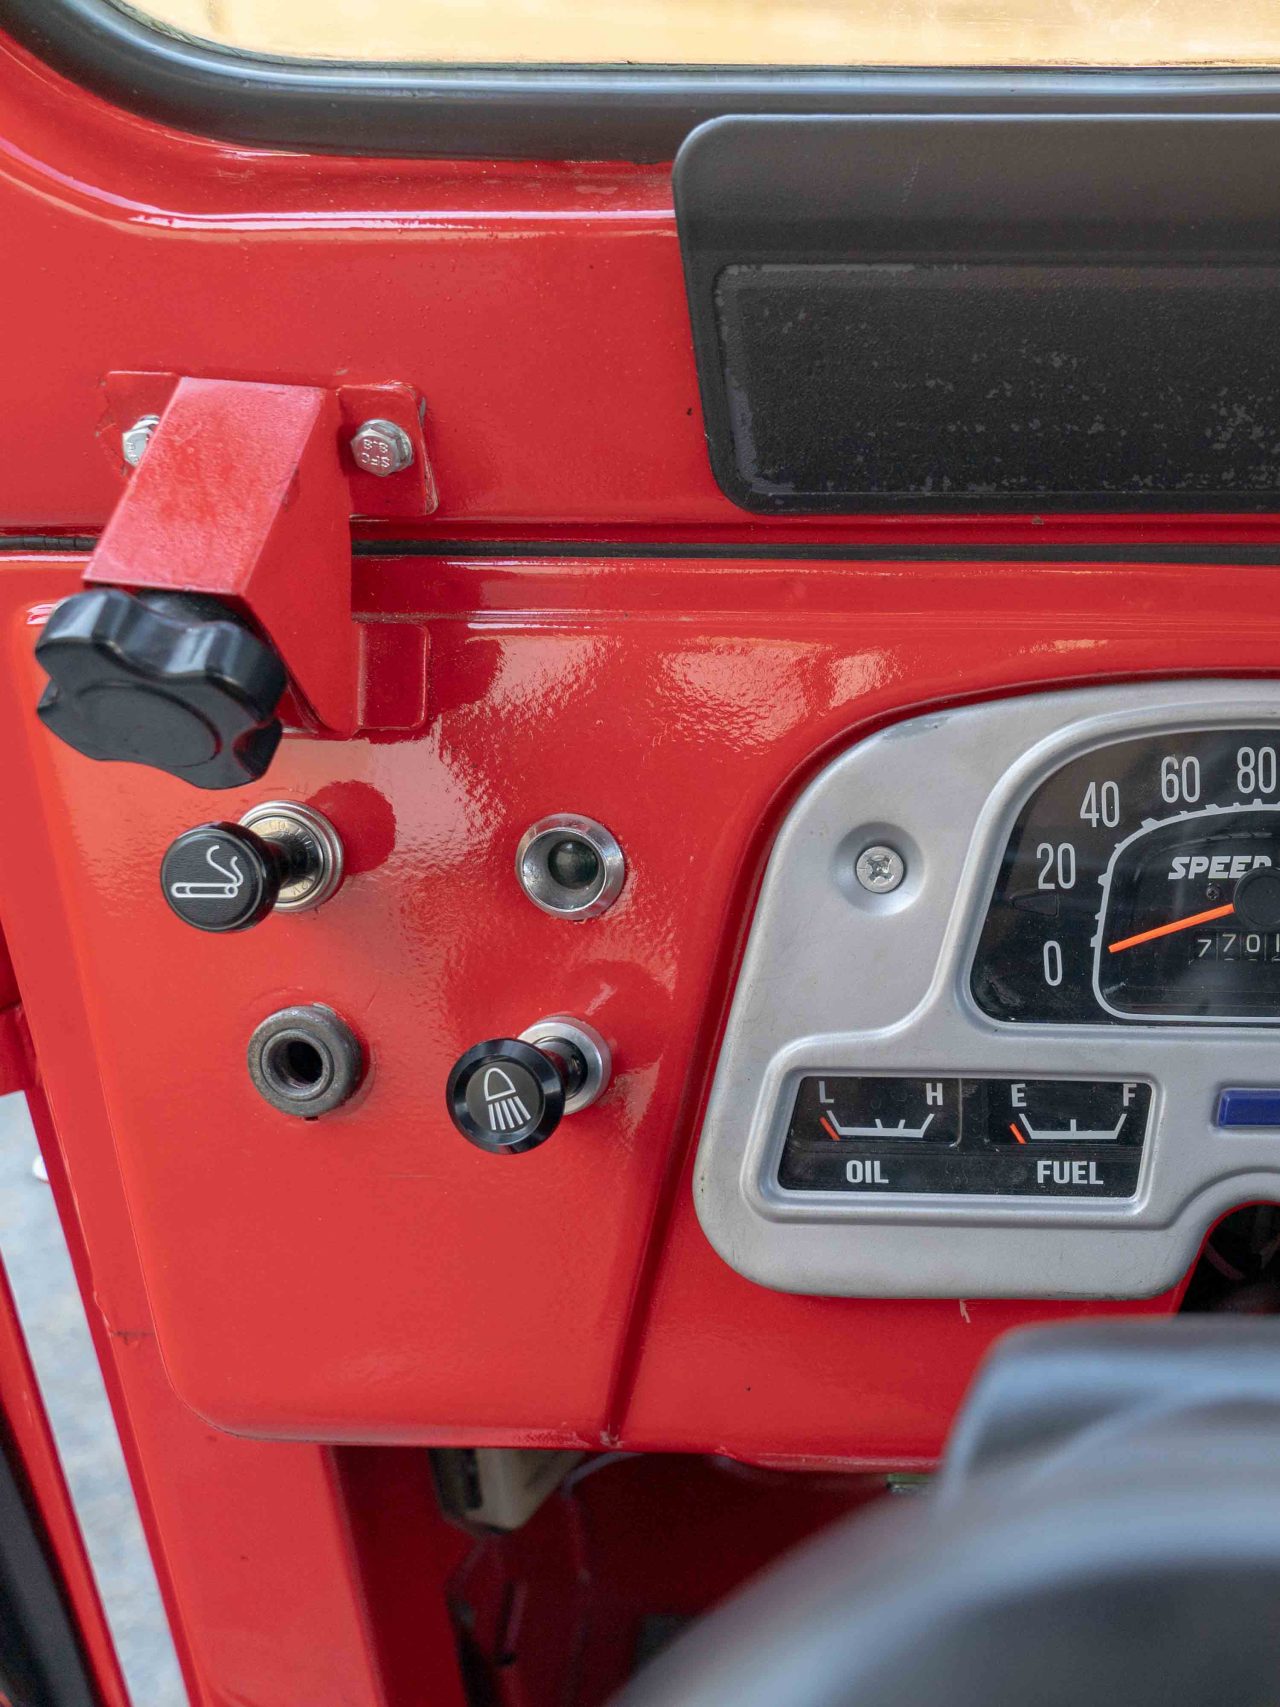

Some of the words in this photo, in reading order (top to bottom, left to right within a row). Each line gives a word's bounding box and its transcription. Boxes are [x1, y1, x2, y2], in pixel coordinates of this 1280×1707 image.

[1161, 755, 1200, 803] 60
[1237, 747, 1276, 793] 80
[1080, 781, 1119, 827] 40
[1037, 843, 1075, 889] 20
[1043, 941, 1063, 986] 0
[819, 1081, 834, 1103] L
[926, 1083, 943, 1105] H
[1011, 1084, 1027, 1107] E
[1122, 1083, 1137, 1107] F
[846, 1160, 889, 1184] OIL
[1037, 1160, 1104, 1185] FUEL
